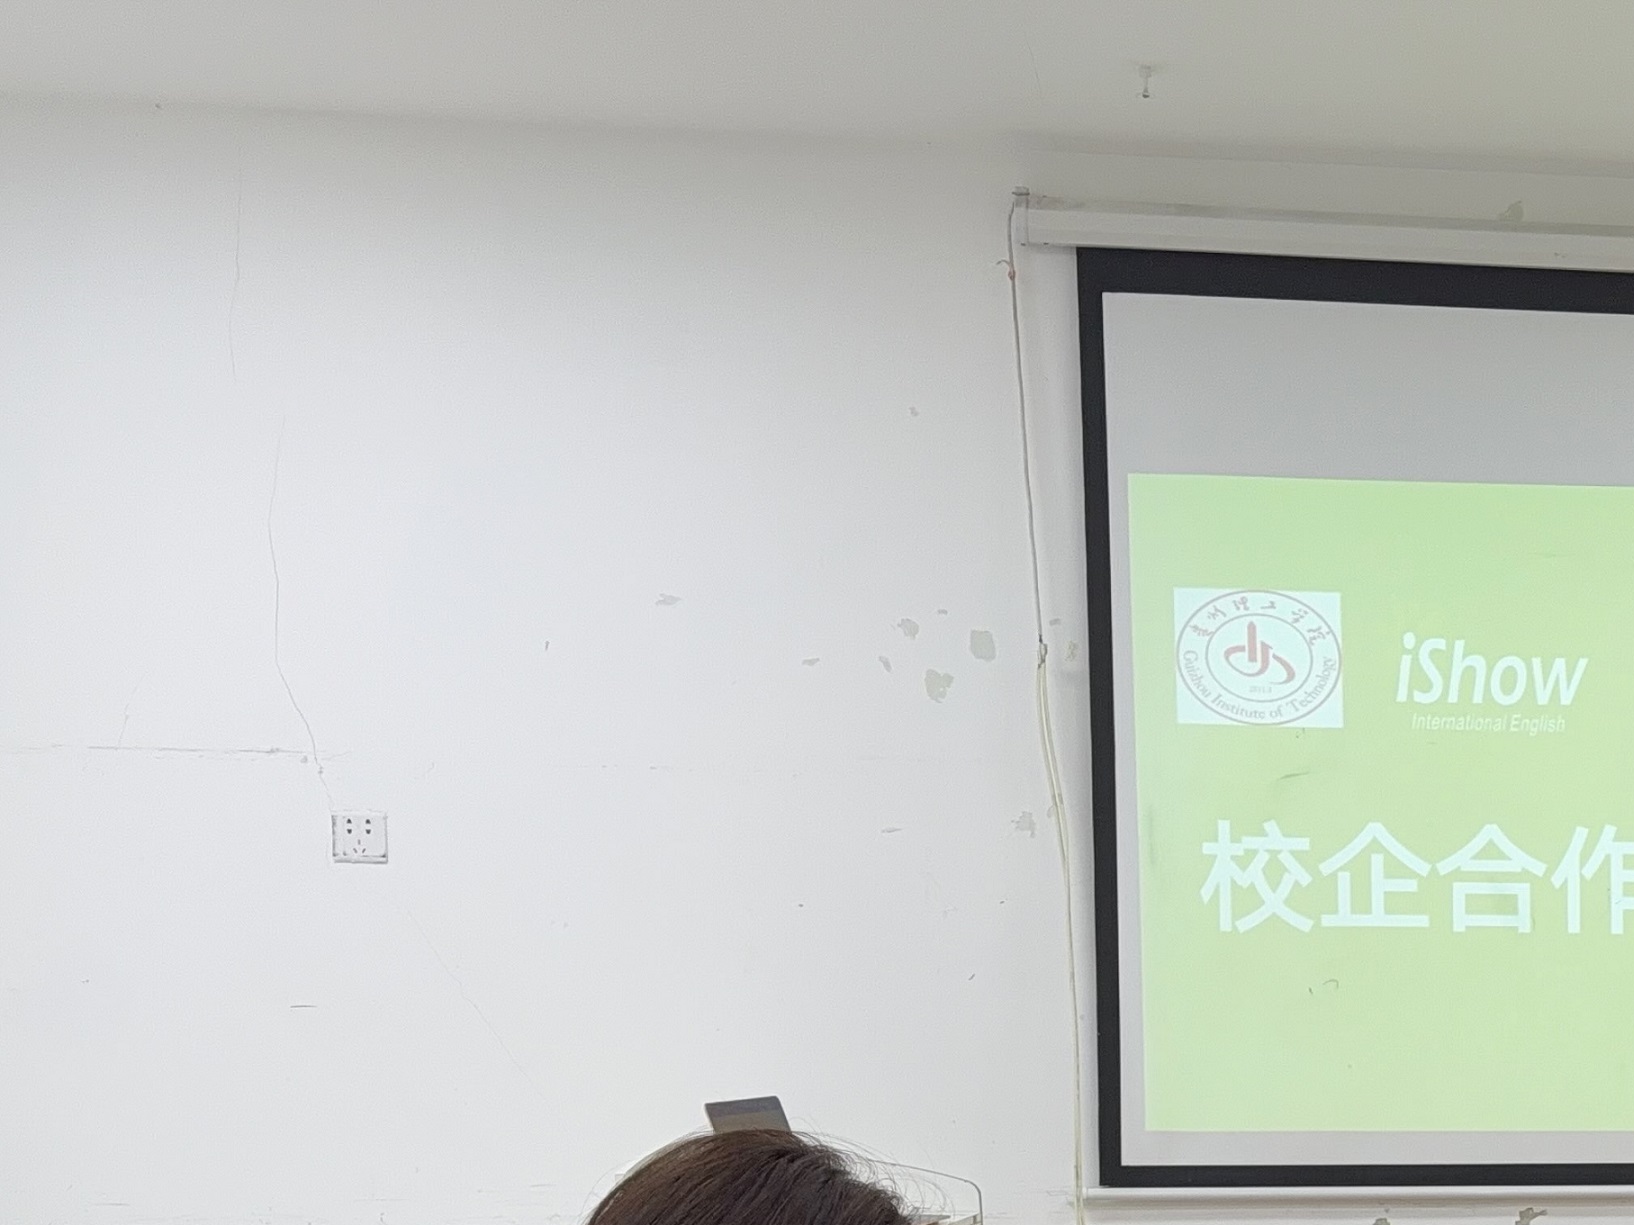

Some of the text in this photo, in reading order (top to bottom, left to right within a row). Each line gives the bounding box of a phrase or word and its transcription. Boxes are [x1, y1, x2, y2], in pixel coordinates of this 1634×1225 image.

[1182, 650, 1337, 720] Guizhou Institute of Technology
[1395, 631, 1589, 706] iShow
[1411, 712, 1566, 736] International English
